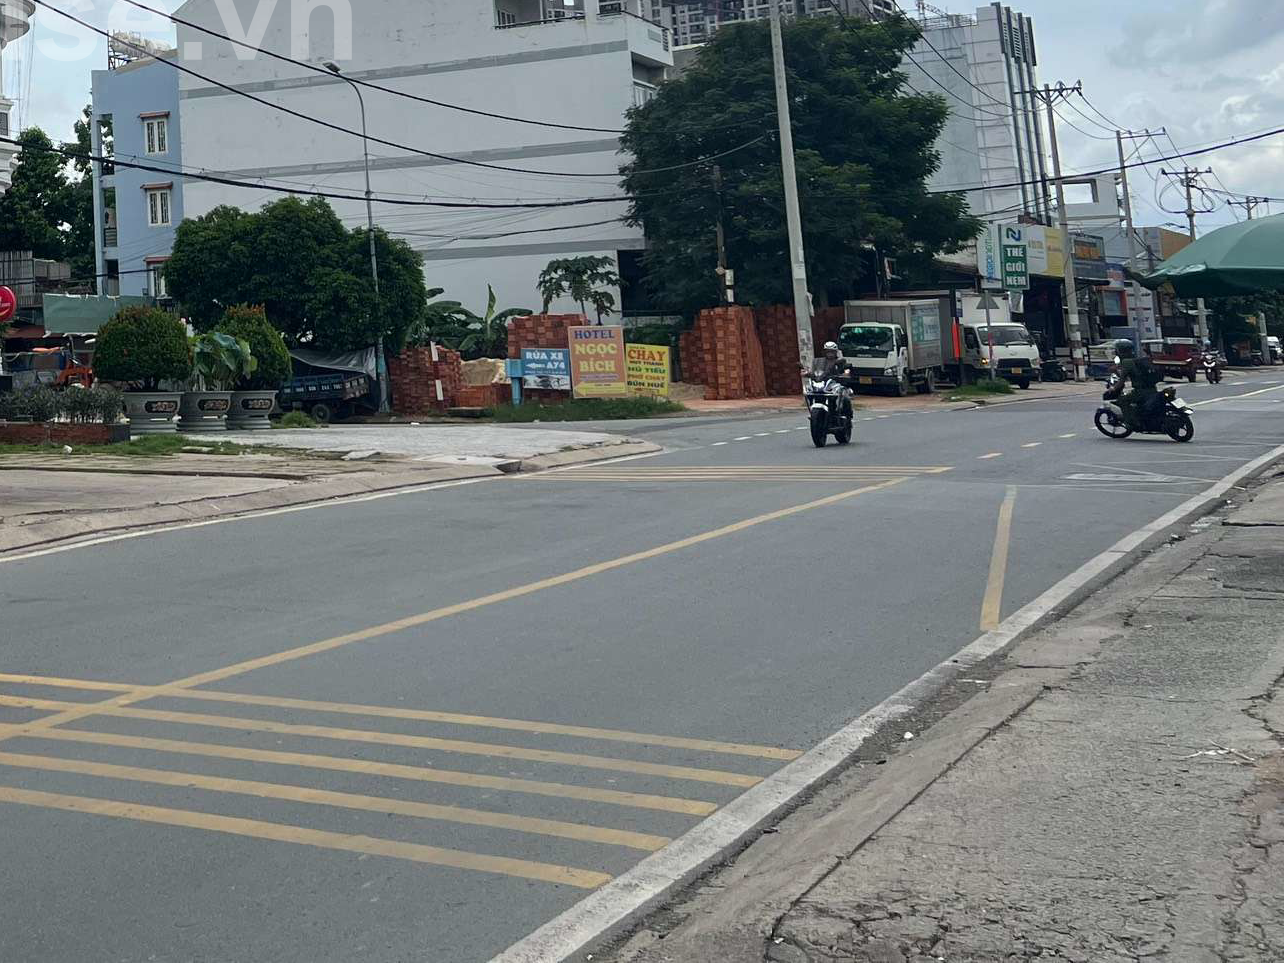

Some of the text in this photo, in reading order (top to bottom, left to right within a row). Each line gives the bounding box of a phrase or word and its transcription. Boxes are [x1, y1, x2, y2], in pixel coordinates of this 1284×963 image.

[574, 329, 615, 340] HOTEL
[575, 343, 618, 358] NGỌC
[627, 349, 666, 362] CHAY
[579, 357, 616, 373] BÍCH
